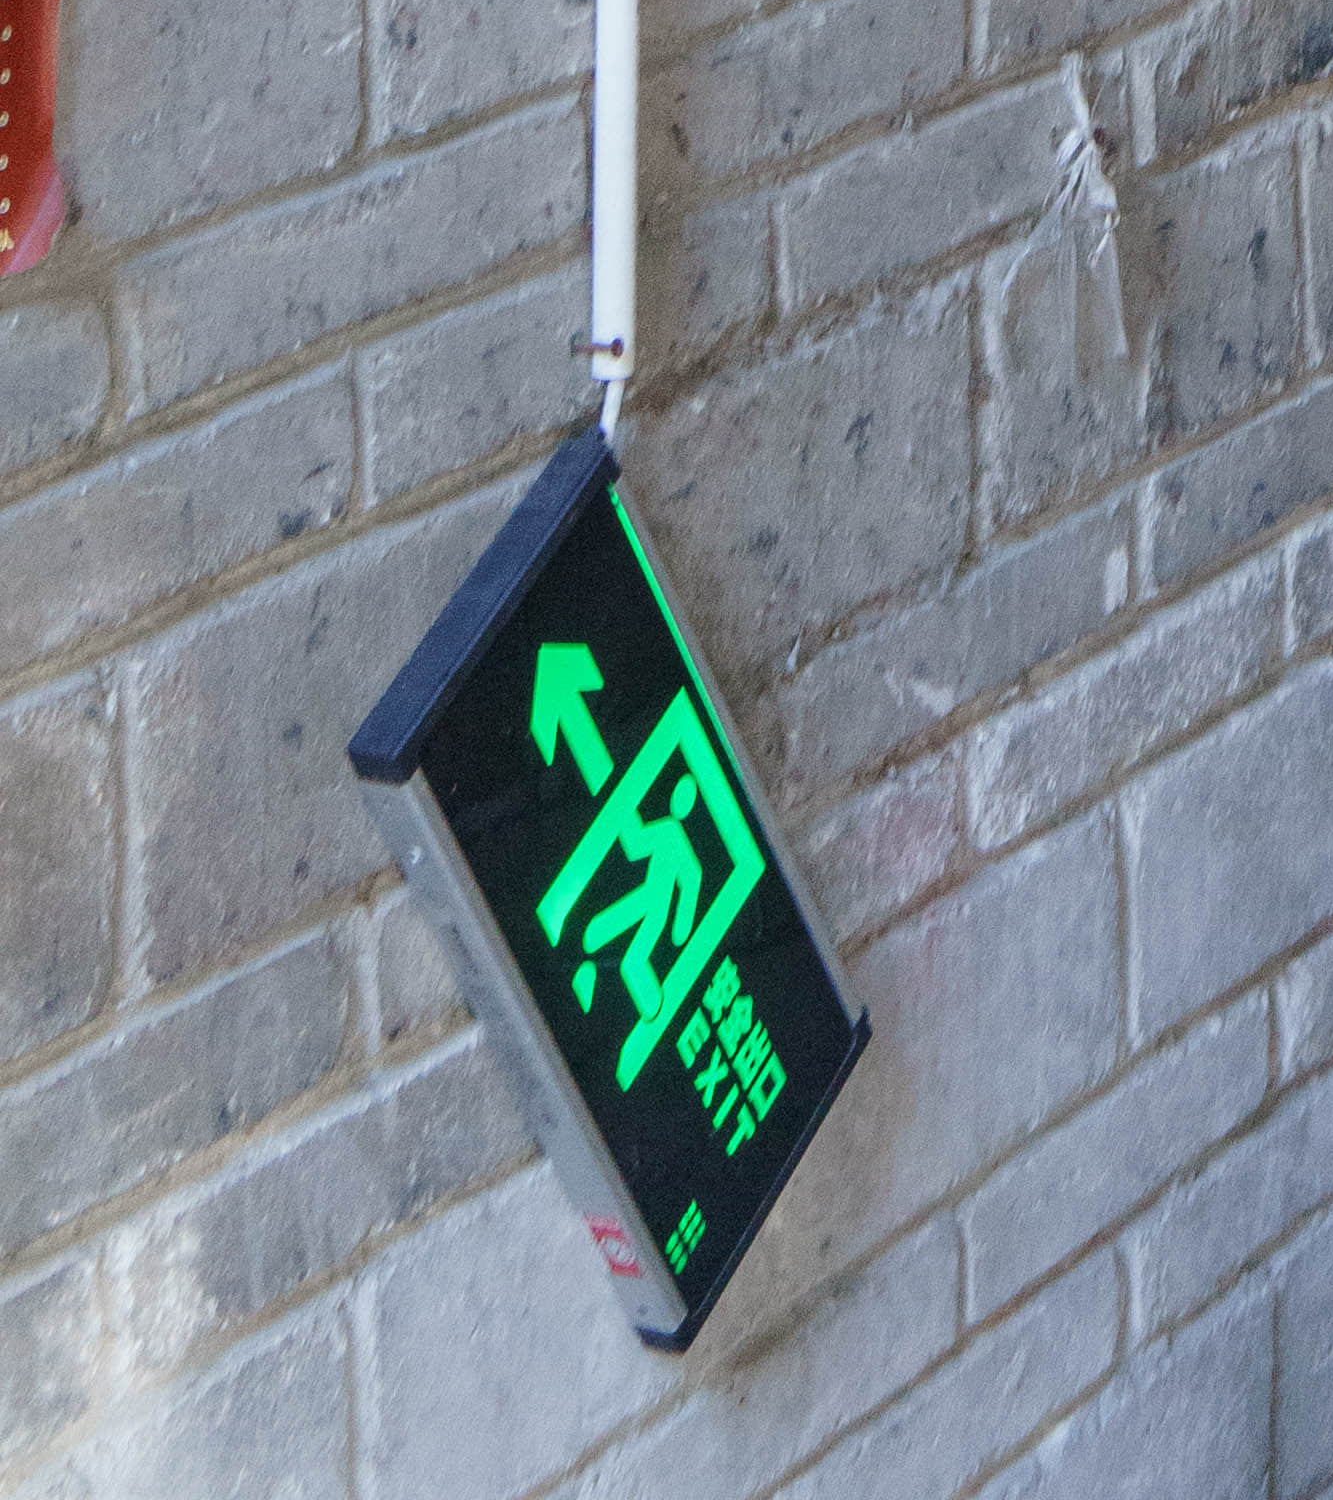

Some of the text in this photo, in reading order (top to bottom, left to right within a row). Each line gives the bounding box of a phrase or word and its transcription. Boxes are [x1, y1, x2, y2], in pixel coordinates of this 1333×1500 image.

[675, 1006, 756, 1157] EXIT
[701, 955, 788, 1123] 安全出口
